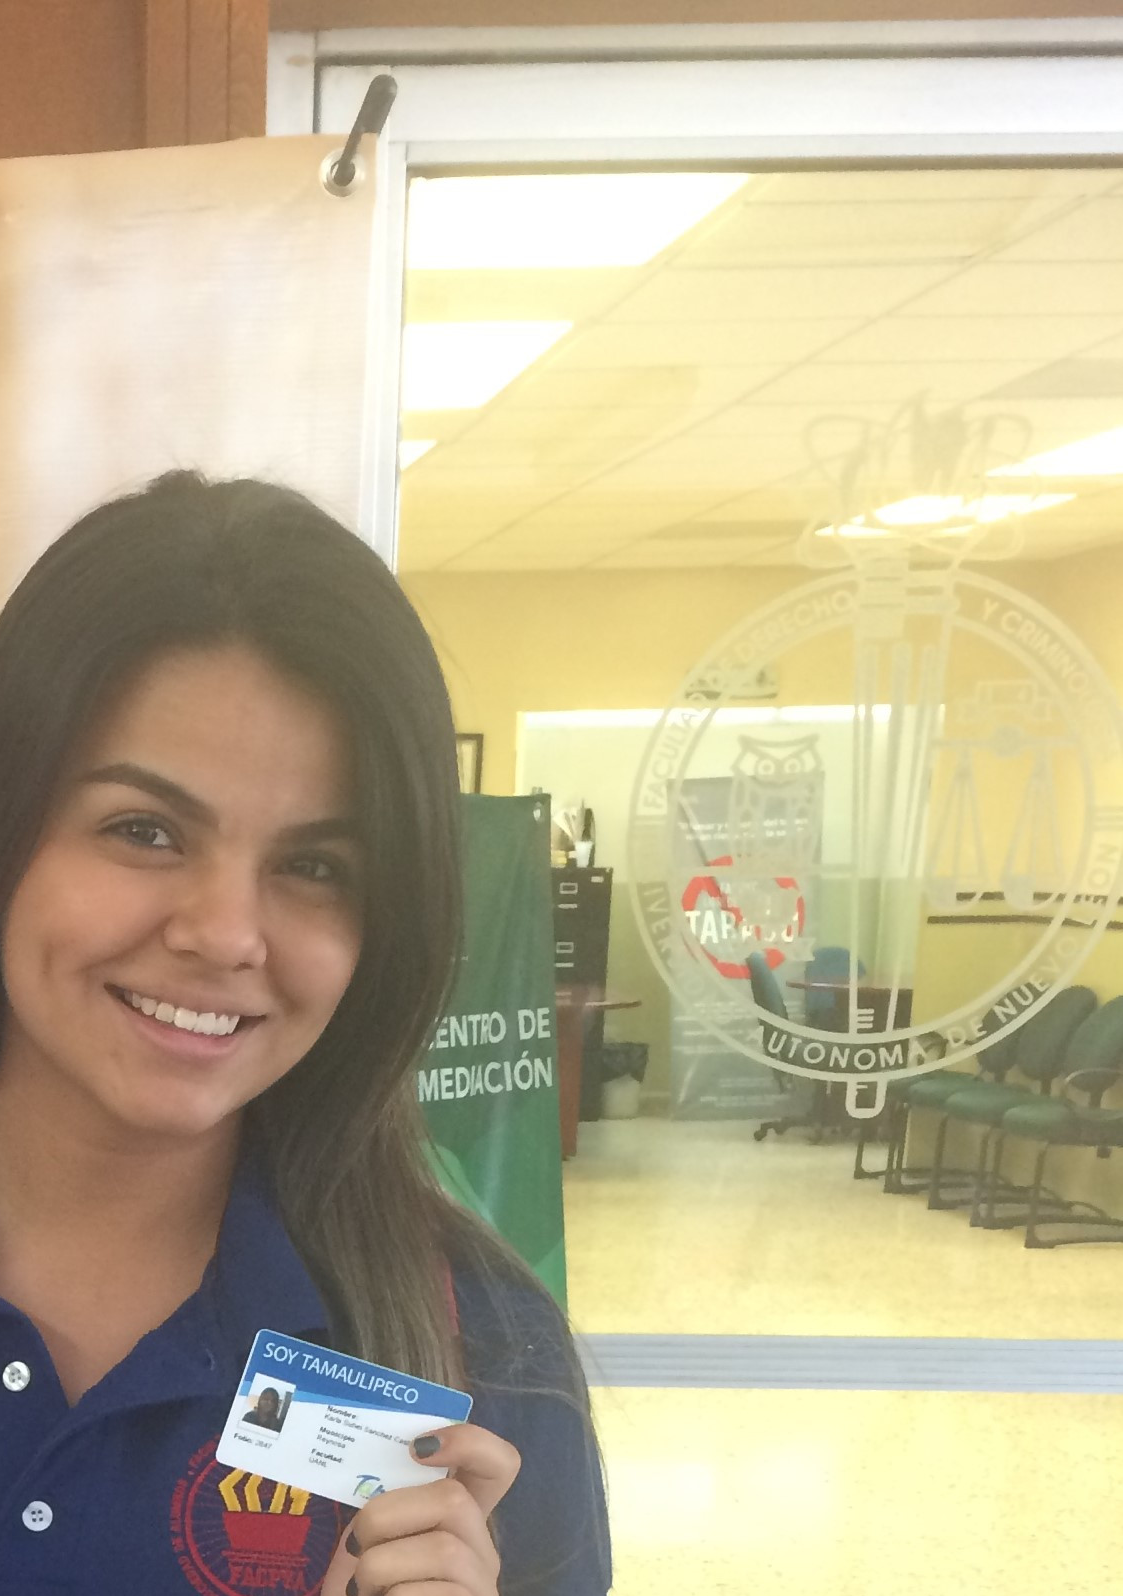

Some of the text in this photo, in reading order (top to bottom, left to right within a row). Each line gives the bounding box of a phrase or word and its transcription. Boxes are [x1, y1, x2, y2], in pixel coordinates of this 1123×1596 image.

[734, 589, 854, 662] DERECHO
[983, 598, 999, 621] Y
[429, 1007, 552, 1050] ENTRO DE
[746, 1022, 928, 1070] AUTONOMA
[947, 1016, 988, 1048] DE
[992, 936, 1076, 1024] NUEVO
[417, 1050, 554, 1103] MEDIACIÓN
[263, 1342, 419, 1404] SOY TAMAULIPECO
